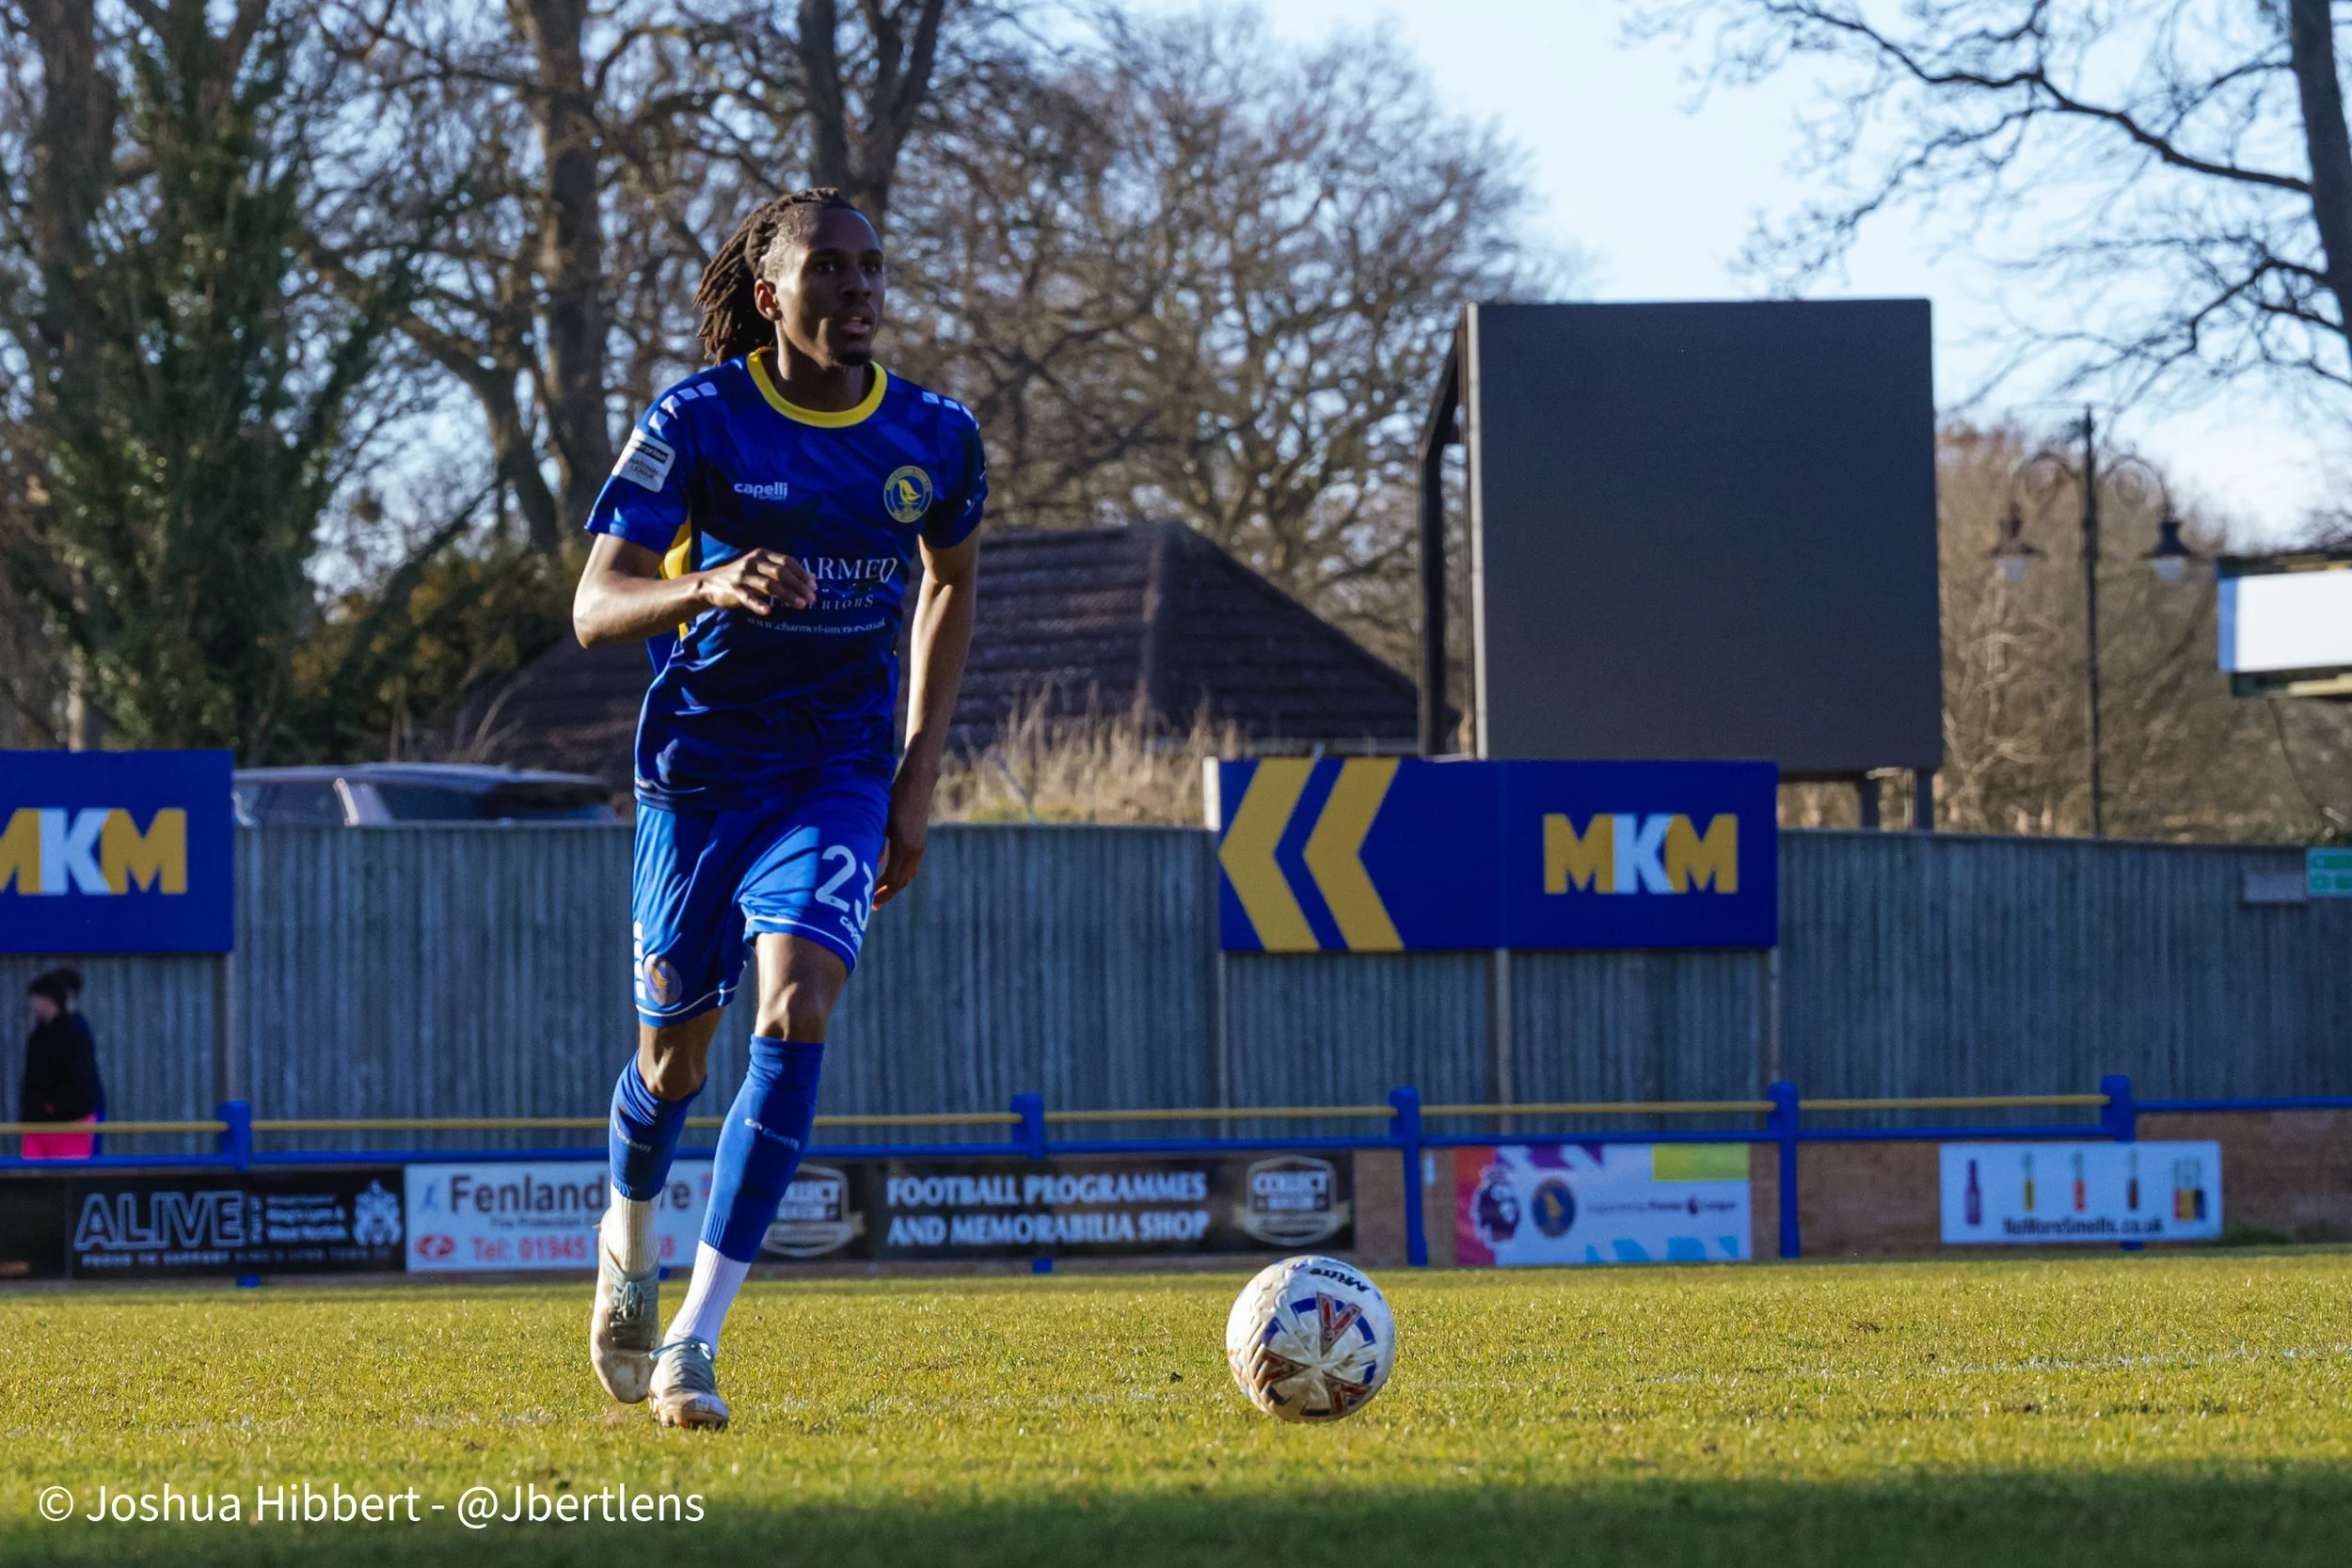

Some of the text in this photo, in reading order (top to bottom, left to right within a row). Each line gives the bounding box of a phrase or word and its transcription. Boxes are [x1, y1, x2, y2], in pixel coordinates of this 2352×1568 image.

[734, 482, 787, 498] capelli
[799, 558, 898, 583] ARMED
[769, 594, 874, 610] INERIORS
[1543, 814, 1739, 894] MKM
[815, 845, 874, 931] 23
[451, 1175, 605, 1214] Fenland
[887, 1172, 1208, 1207] FOOTBALL PROGRAMMES
[73, 1192, 245, 1250] ALIVE
[887, 1211, 1210, 1246] AND MEMORABILIA SHOP
[471, 1237, 505, 1261] Tel:
[518, 1235, 588, 1261] 01945
